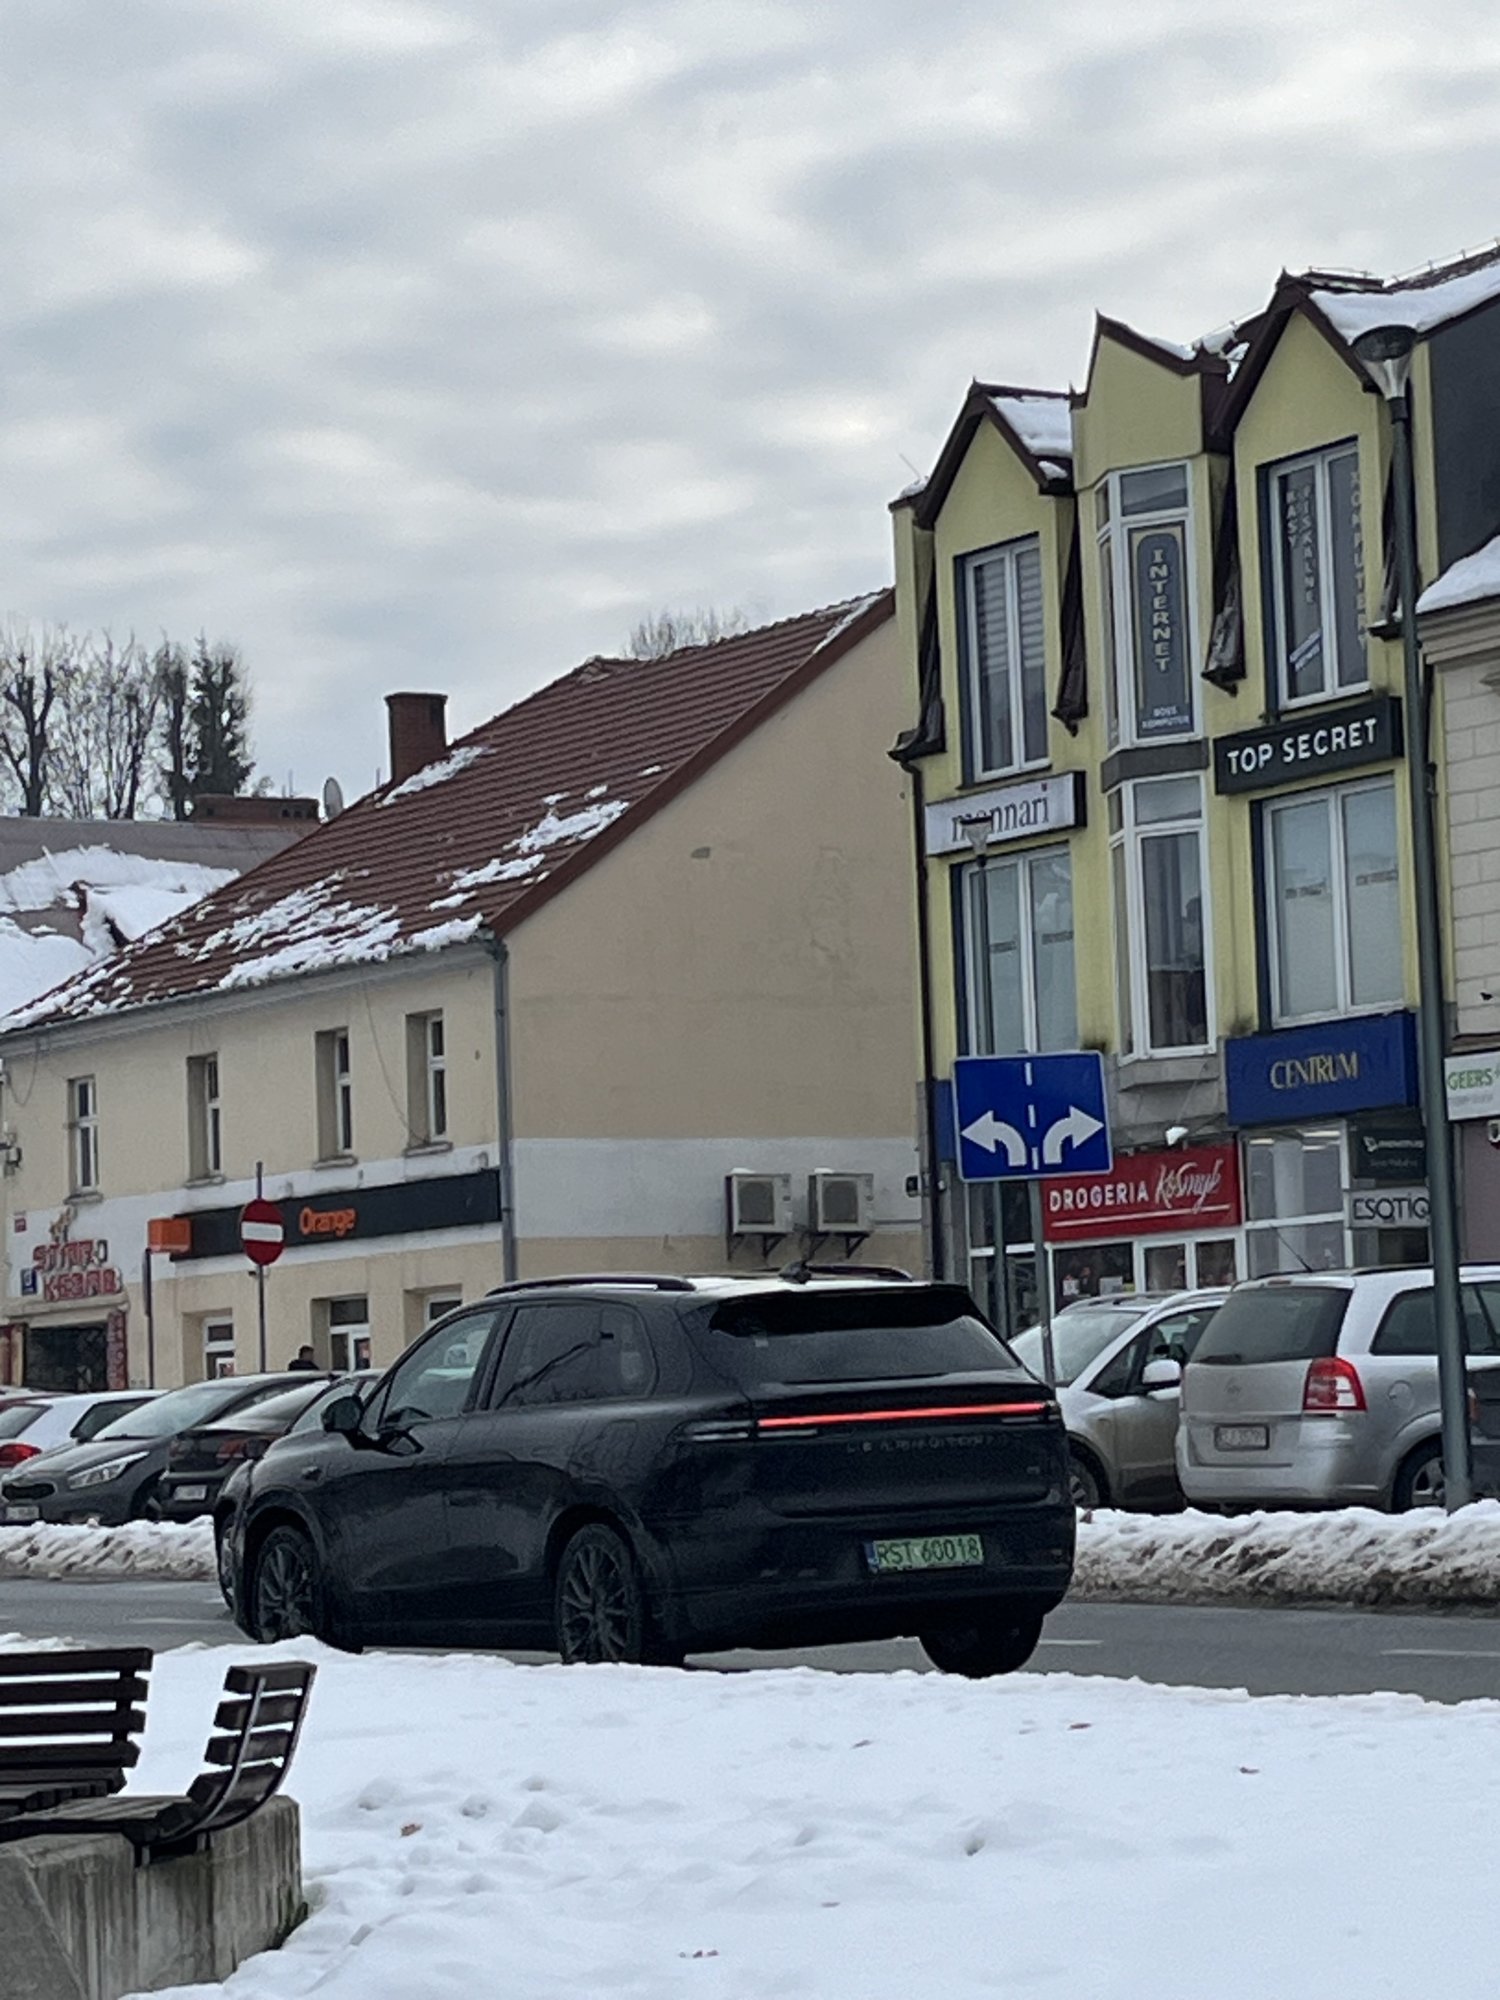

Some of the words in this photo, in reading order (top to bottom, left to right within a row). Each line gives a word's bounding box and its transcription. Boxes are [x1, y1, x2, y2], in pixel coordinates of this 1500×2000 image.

[1149, 549, 1172, 672] INTERNET
[1226, 743, 1273, 775] TOP
[1282, 718, 1379, 764] SECRET
[1269, 1050, 1359, 1091] CENTRUM
[1448, 1068, 1493, 1090] GEERS
[1049, 1182, 1149, 1212] DROGERIA
[300, 1207, 356, 1236] Orange
[43, 1268, 123, 1302] KEBAB
[876, 1541, 914, 1565] RST
[920, 1537, 981, 1563] 60018
